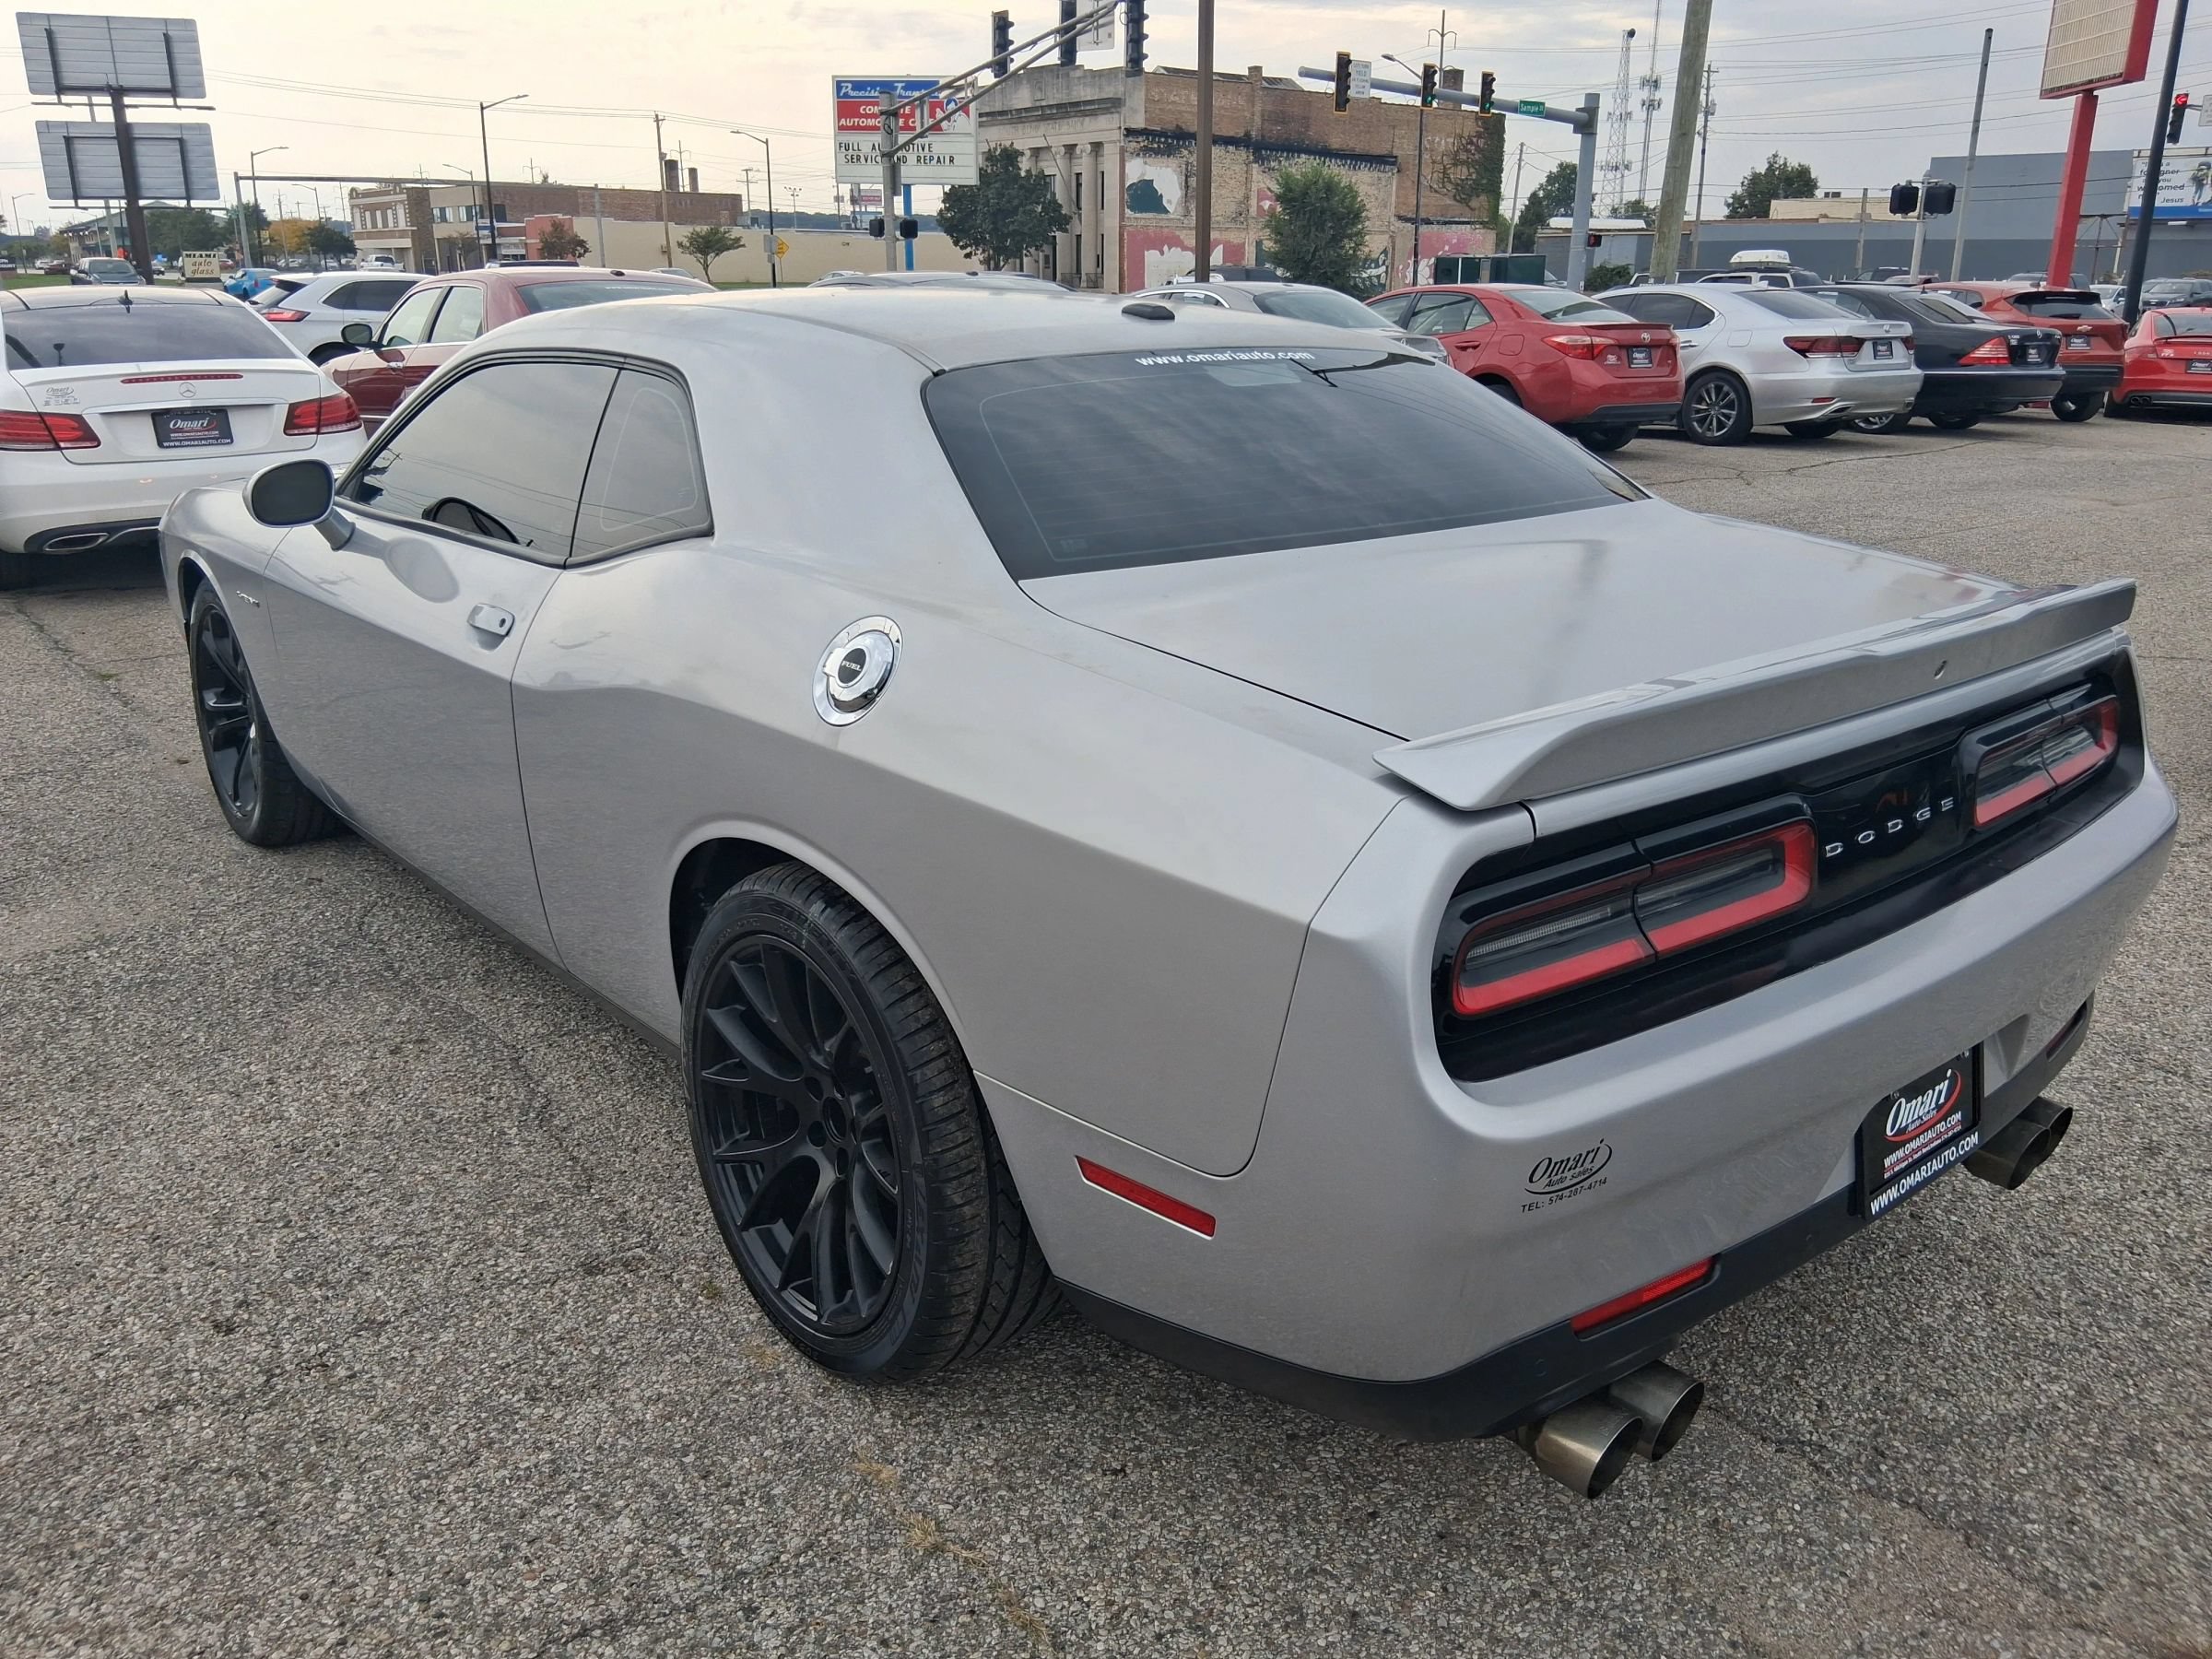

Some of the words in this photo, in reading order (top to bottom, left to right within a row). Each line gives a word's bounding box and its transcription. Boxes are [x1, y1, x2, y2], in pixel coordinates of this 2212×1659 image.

[840, 83, 880, 96] Precisi
[840, 118, 905, 126] AUTOMOE
[839, 142, 862, 151] FULL
[871, 143, 933, 153] AUOTIVE
[844, 154, 883, 164] SERVIC
[917, 155, 955, 165] REPAIR
[192, 259, 212, 267] auto
[191, 267, 215, 276] glass
[170, 418, 209, 429] Omari
[841, 661, 862, 671] FUEL
[1826, 797, 1954, 858] DODGE
[1886, 1068, 1952, 1136] Omari
[1884, 1111, 1961, 1168] WWW.OMARIAUTO.COM
[1528, 1137, 1605, 1184] Omari
[1542, 1176, 1568, 1190] Auto
[1570, 1165, 1594, 1181] Sales
[1870, 1132, 1979, 1216] WWW.OMARIAUTO.COM
[1521, 1201, 1545, 1214] TEL:
[1548, 1176, 1607, 1206] 574-287-4714
